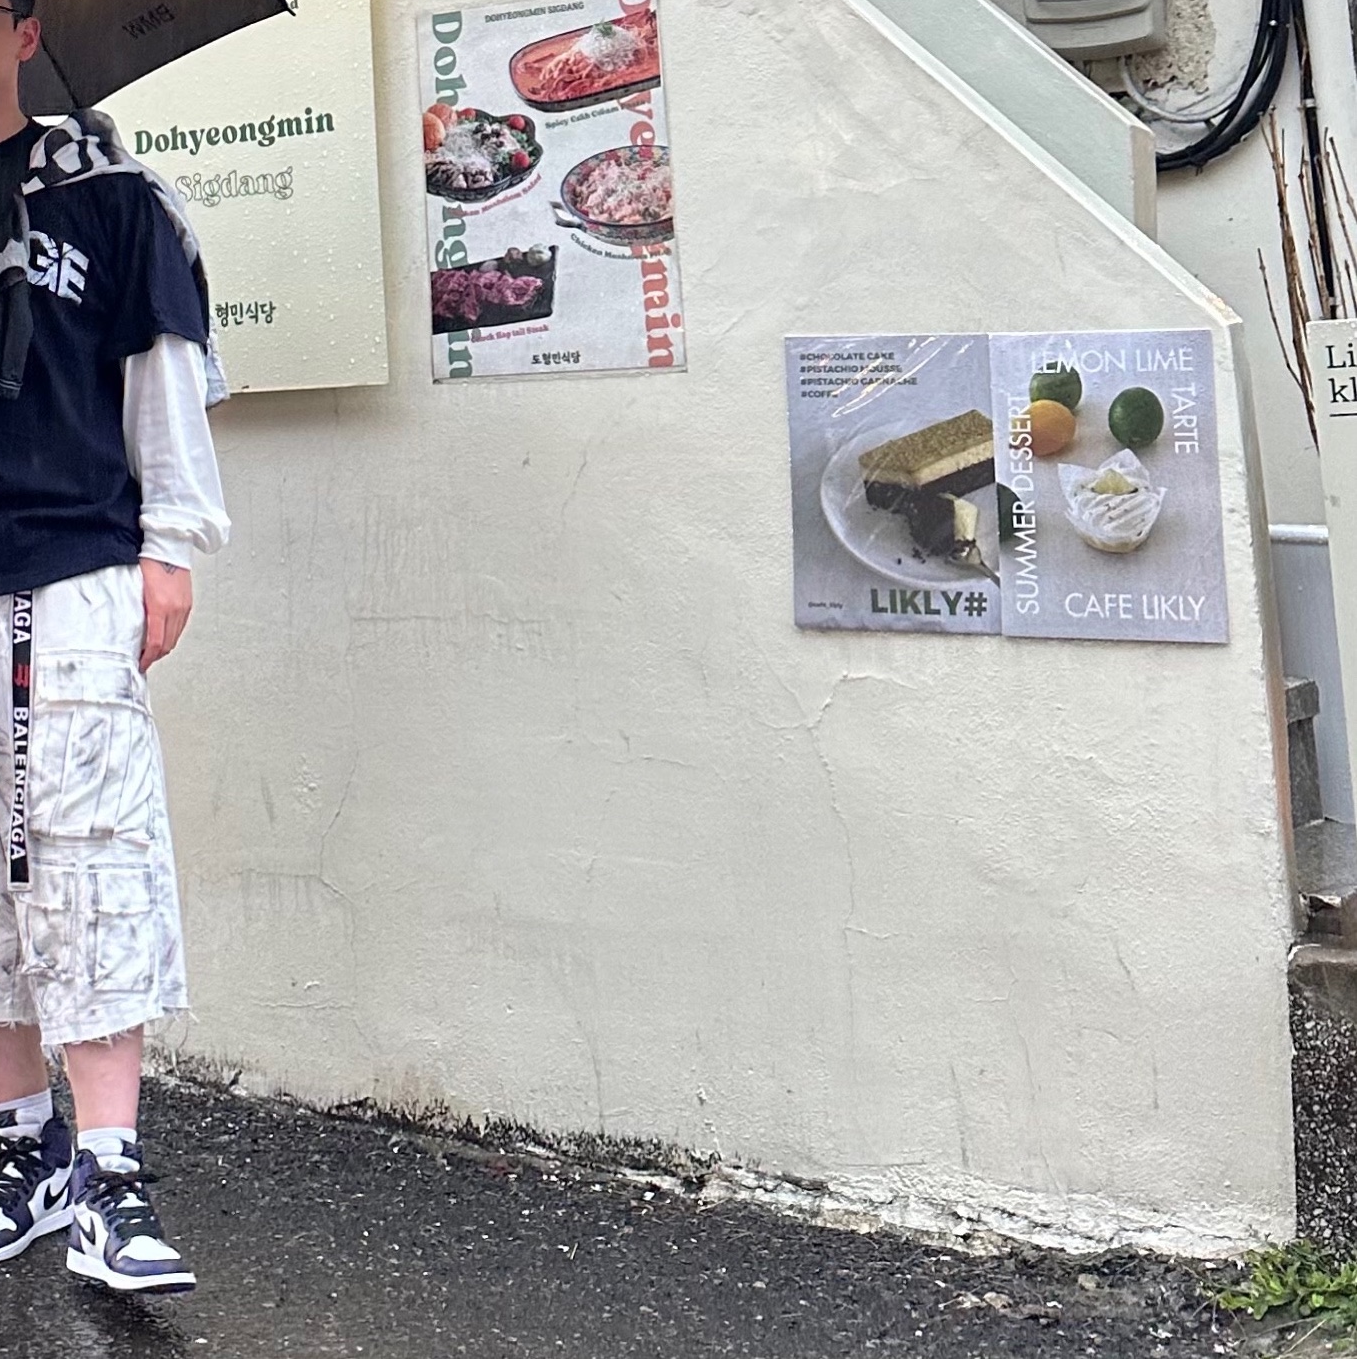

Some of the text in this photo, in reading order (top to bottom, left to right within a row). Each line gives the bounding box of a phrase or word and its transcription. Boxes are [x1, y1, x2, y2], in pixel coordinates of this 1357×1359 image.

[134, 106, 335, 155] Dohyeongmin
[175, 166, 294, 207] Sigdang
[531, 350, 581, 365] 도형민식당
[866, 352, 895, 361] CAKE
[1030, 348, 1193, 374] LEMON LIME
[1171, 382, 1199, 454] TARTE
[1008, 392, 1040, 615] SUMMER DESSERT
[870, 588, 988, 617] LIKLY#
[1064, 592, 1206, 621] CAFE LIKLY
[10, 706, 30, 860] BALENCIAGA
